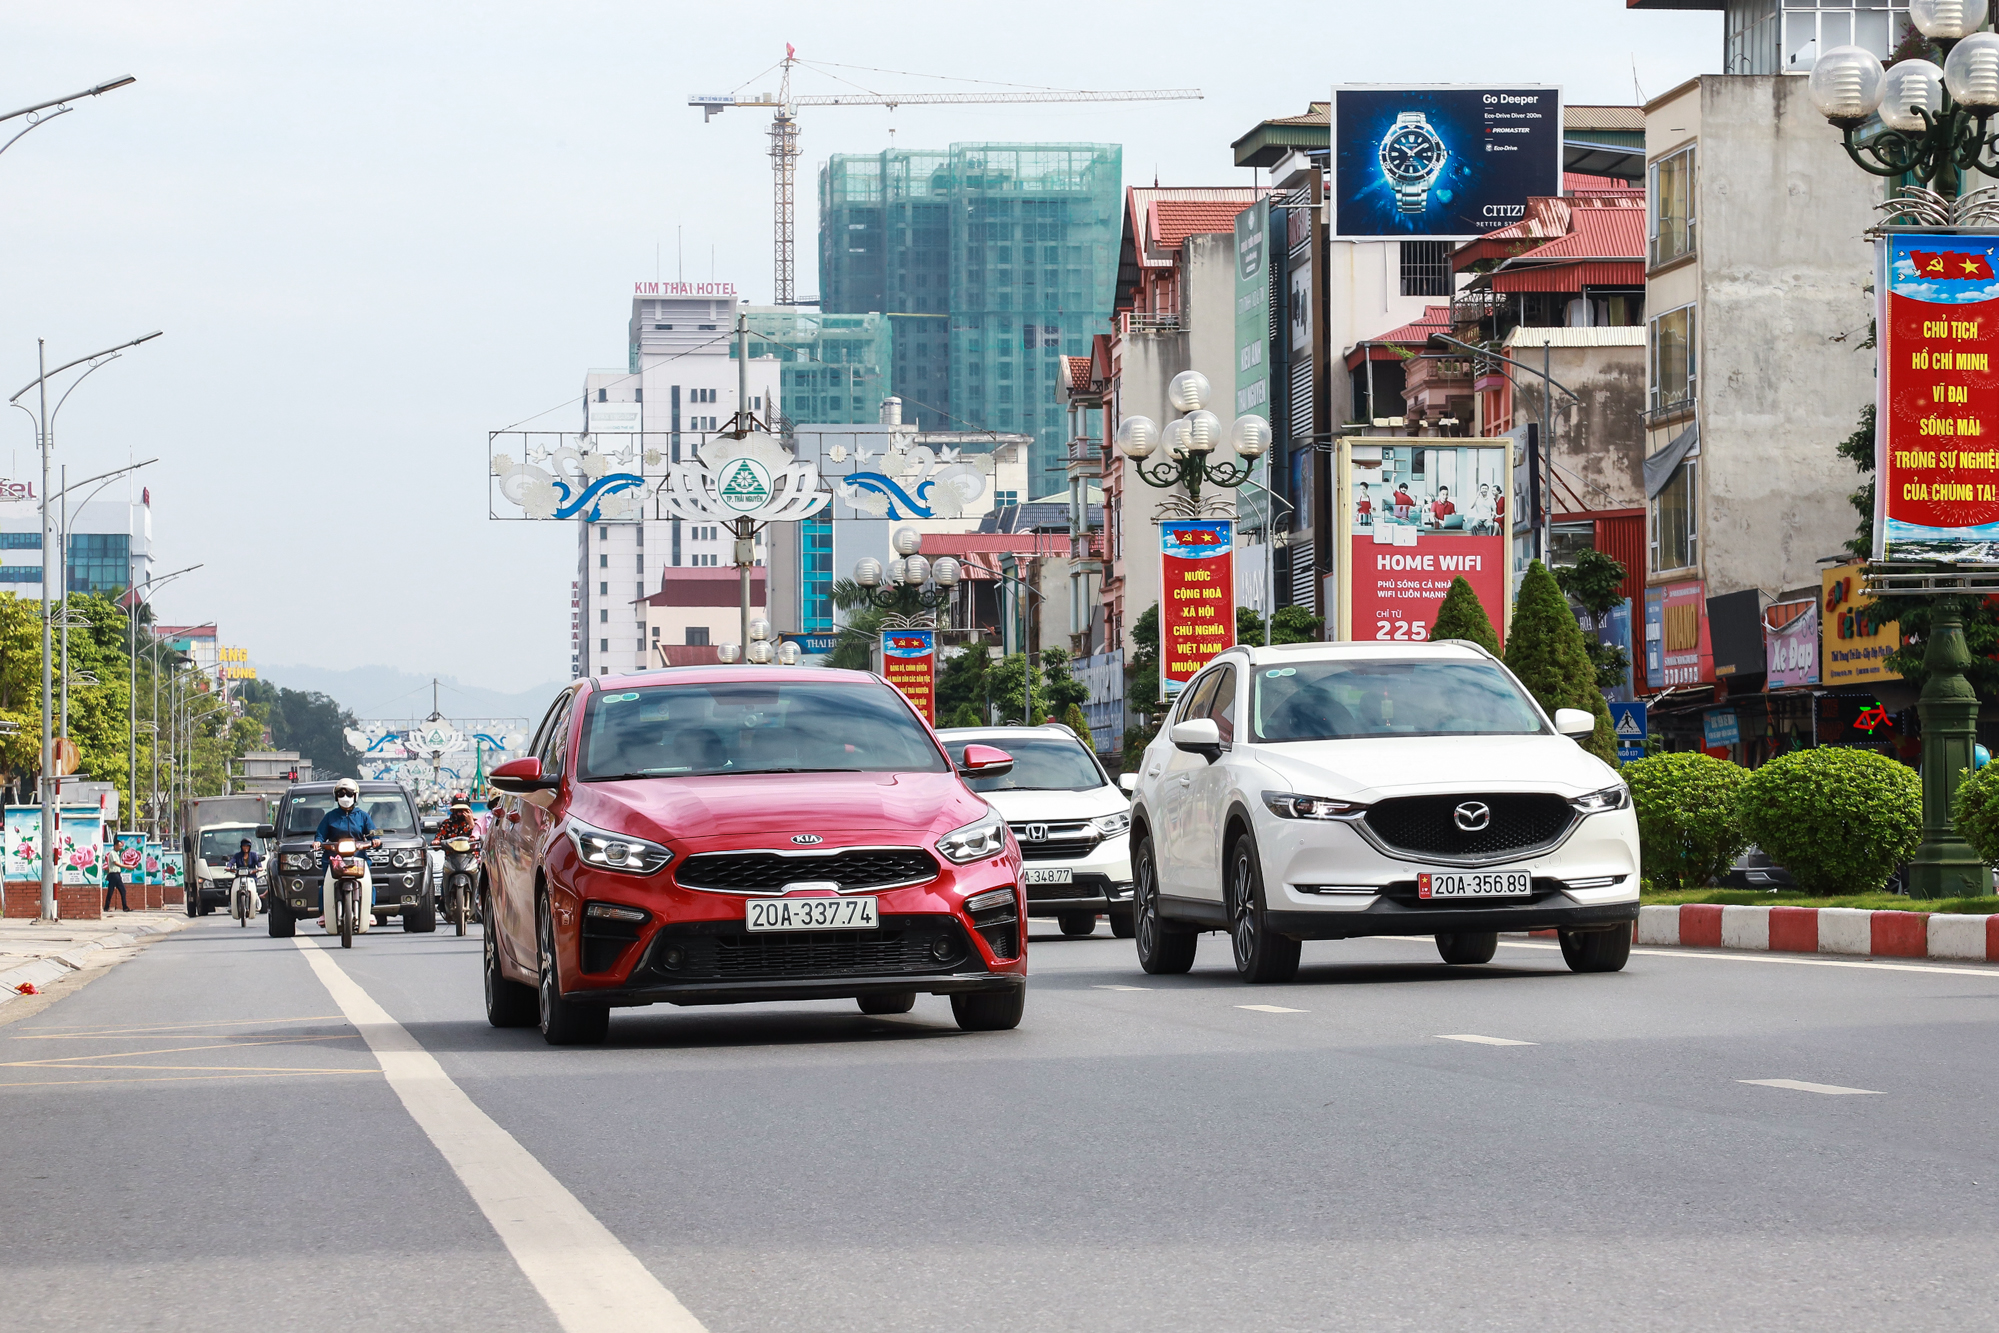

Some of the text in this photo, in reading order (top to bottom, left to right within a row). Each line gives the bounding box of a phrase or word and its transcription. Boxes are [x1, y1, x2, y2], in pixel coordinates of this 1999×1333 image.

[1482, 94, 1538, 106] Go Deeper
[634, 282, 738, 295] KIM THAI HOTEL
[1923, 314, 1978, 342] CHỦ TỊCH
[1912, 347, 1988, 371] HỒ CHÍ MINH
[1932, 382, 1968, 407] VĨ ĐẠI
[1920, 413, 1980, 436] SỐNG MÃI
[1894, 451, 1936, 469] TRONG
[1940, 450, 1958, 472] SỰ
[1903, 477, 1996, 502] CỦA CHÚNG TA!
[735, 494, 744, 502] THÁI
[746, 494, 763, 502] NGUYÊN
[1376, 554, 1482, 571] HOME WIFI
[1184, 568, 1211, 582] NƯỚC
[1377, 579, 1452, 588] PHỦ SÓNG CẢ NHÀ
[1174, 586, 1222, 601] CỘNG HOÀ
[1377, 589, 1447, 600] WIFI LUÔN MẠNH
[1182, 605, 1215, 619] XÃ HỘI
[1376, 609, 1402, 618] CHỈ TỪ
[1173, 622, 1225, 636] CHỦ NGHĨA
[806, 639, 827, 648] THAI
[1176, 642, 1222, 656] VIỆT NAM
[1772, 637, 1813, 680] Xe Đạp
[1172, 660, 1200, 672] MUÔN
[796, 835, 818, 843] KIA
[1025, 870, 1070, 882] A-348.77
[1434, 874, 1527, 895] 20A-356.89
[752, 900, 872, 927] 20A-337.74
